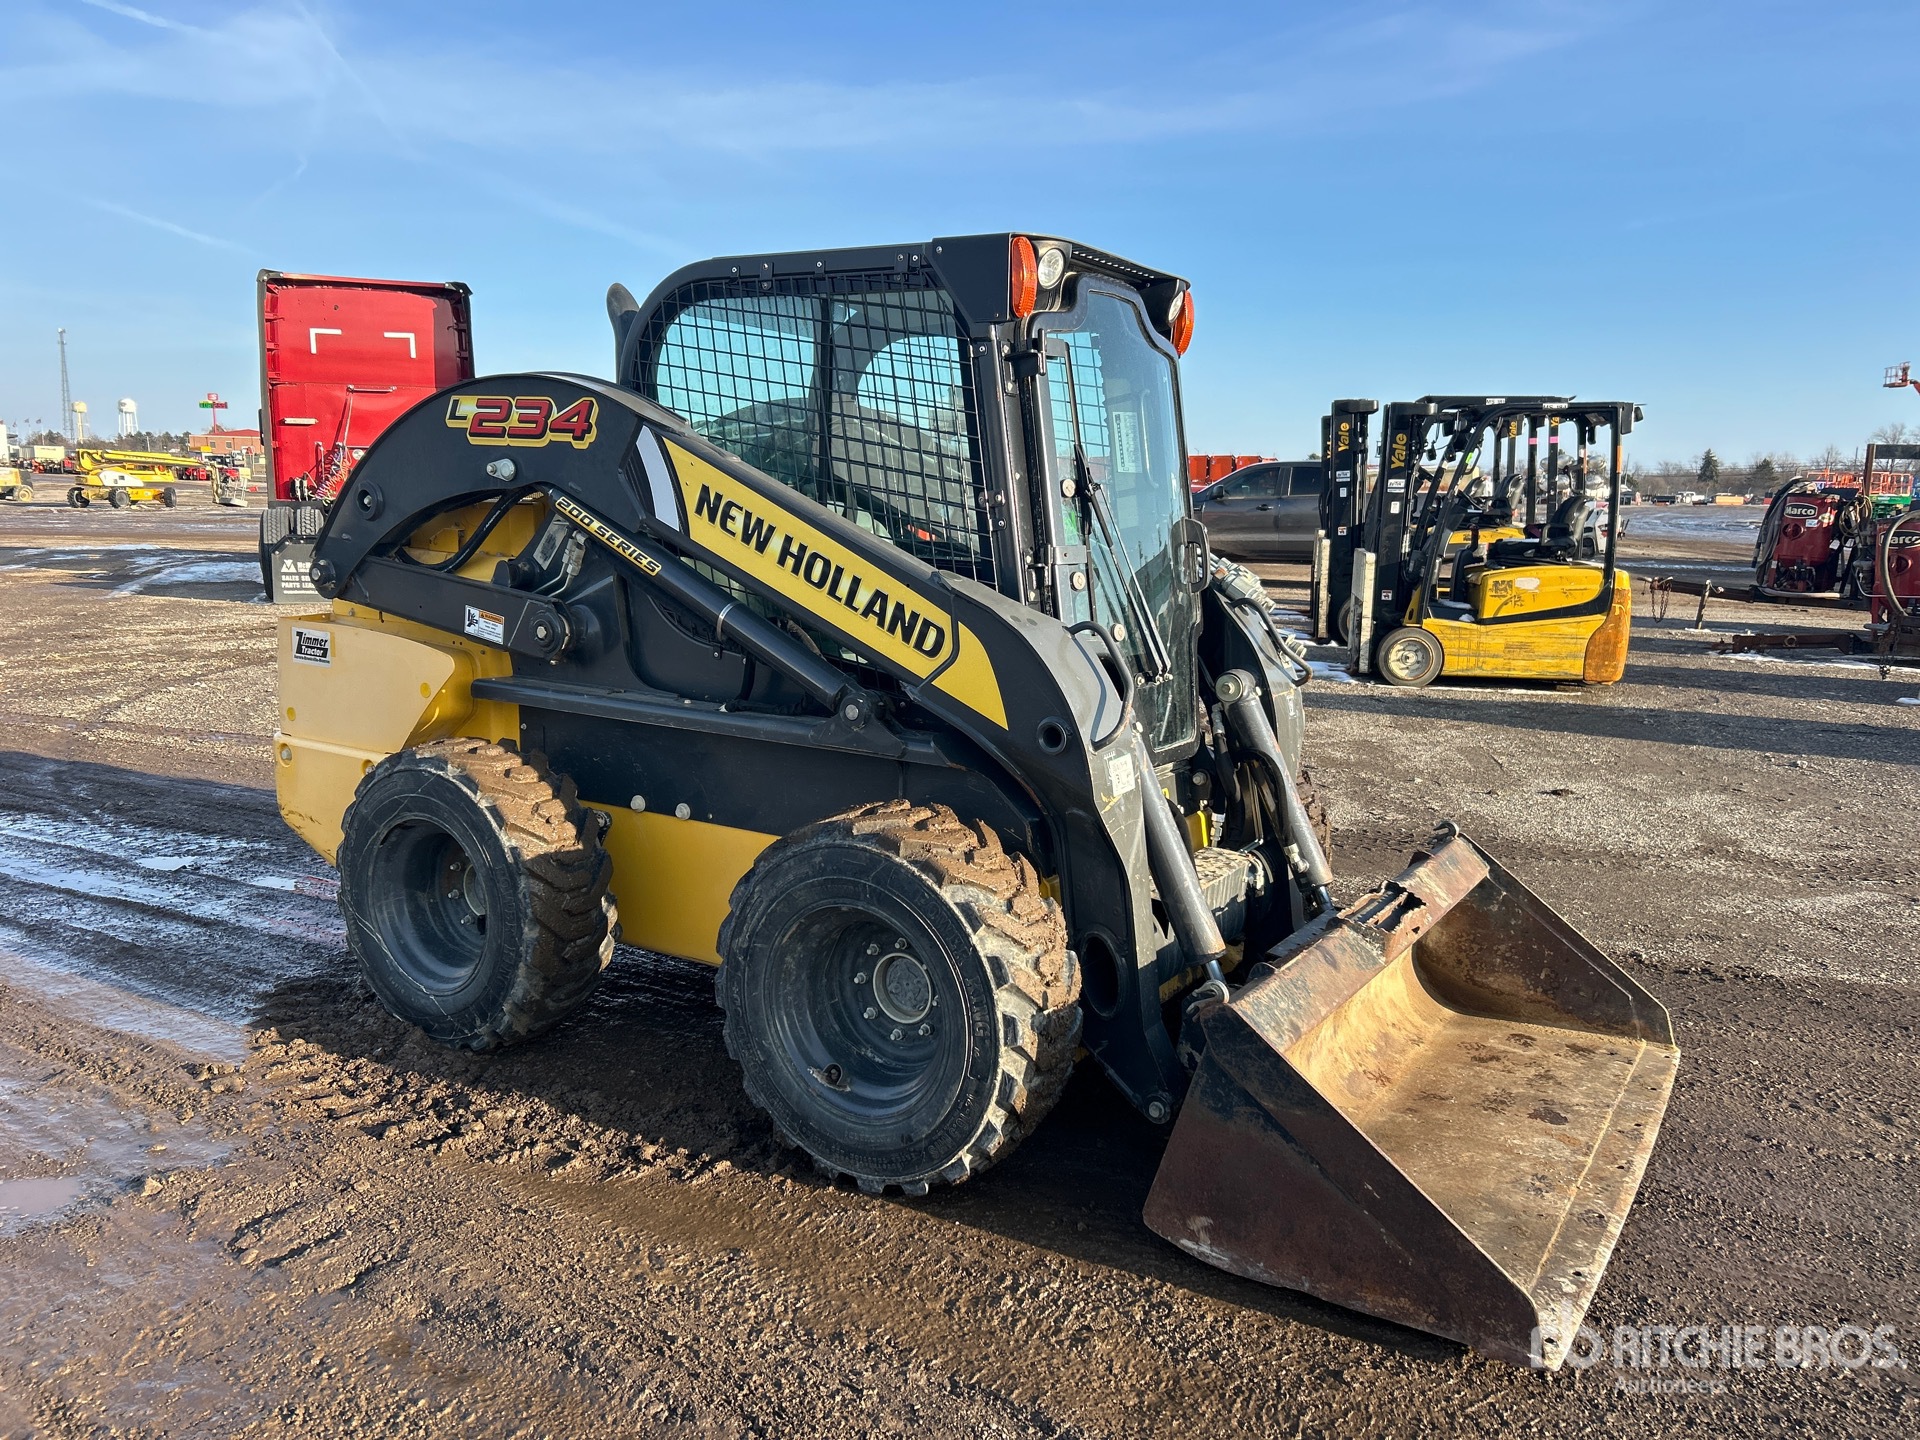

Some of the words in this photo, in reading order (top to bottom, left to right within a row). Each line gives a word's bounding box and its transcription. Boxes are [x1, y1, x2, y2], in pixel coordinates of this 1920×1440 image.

[446, 396, 598, 449] L234
[1338, 422, 1350, 452] Yale
[1391, 433, 1407, 469] Yale
[556, 498, 595, 528] 200
[594, 525, 660, 574] SERIES
[1785, 506, 1815, 516] Marco
[694, 483, 776, 555] NEW
[776, 533, 946, 659] HOLLAND
[964, 974, 990, 1038] KING
